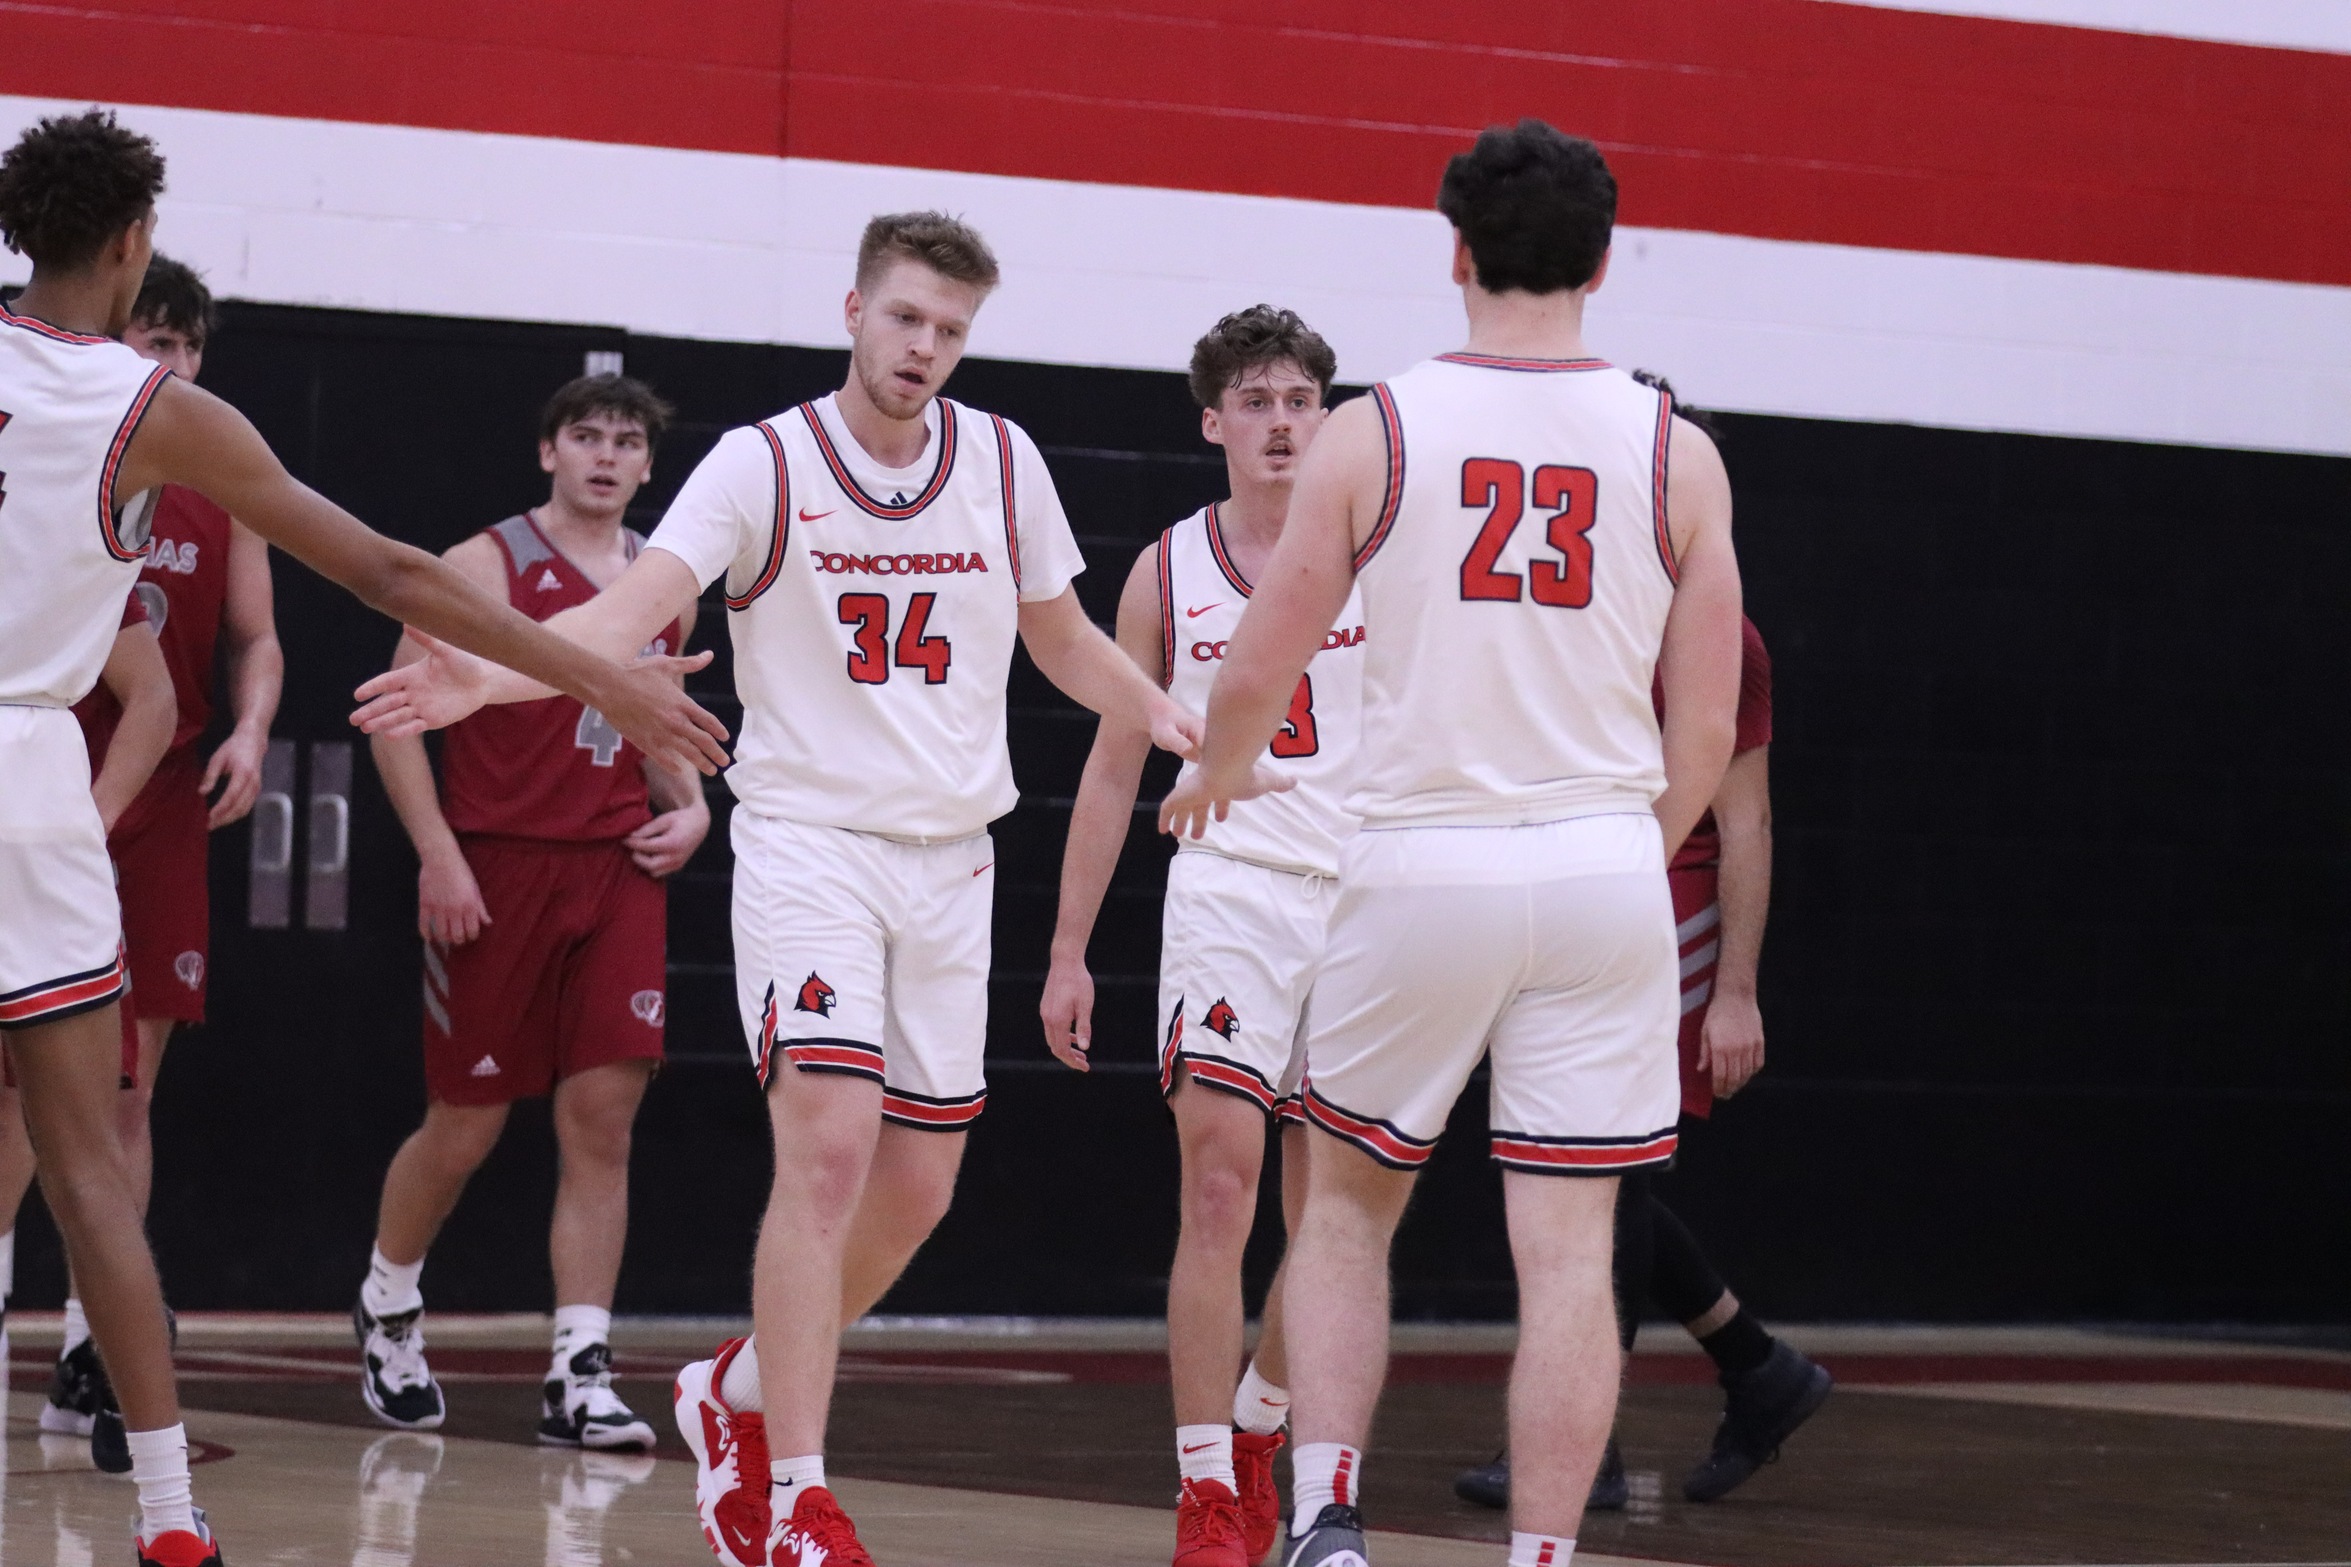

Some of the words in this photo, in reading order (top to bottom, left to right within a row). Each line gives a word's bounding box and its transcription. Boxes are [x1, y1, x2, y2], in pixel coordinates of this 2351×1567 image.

[810, 550, 988, 576] CONCORDIA
[1460, 457, 1598, 609] 23
[838, 592, 951, 685] 34
[1191, 626, 1366, 661] CODIA
